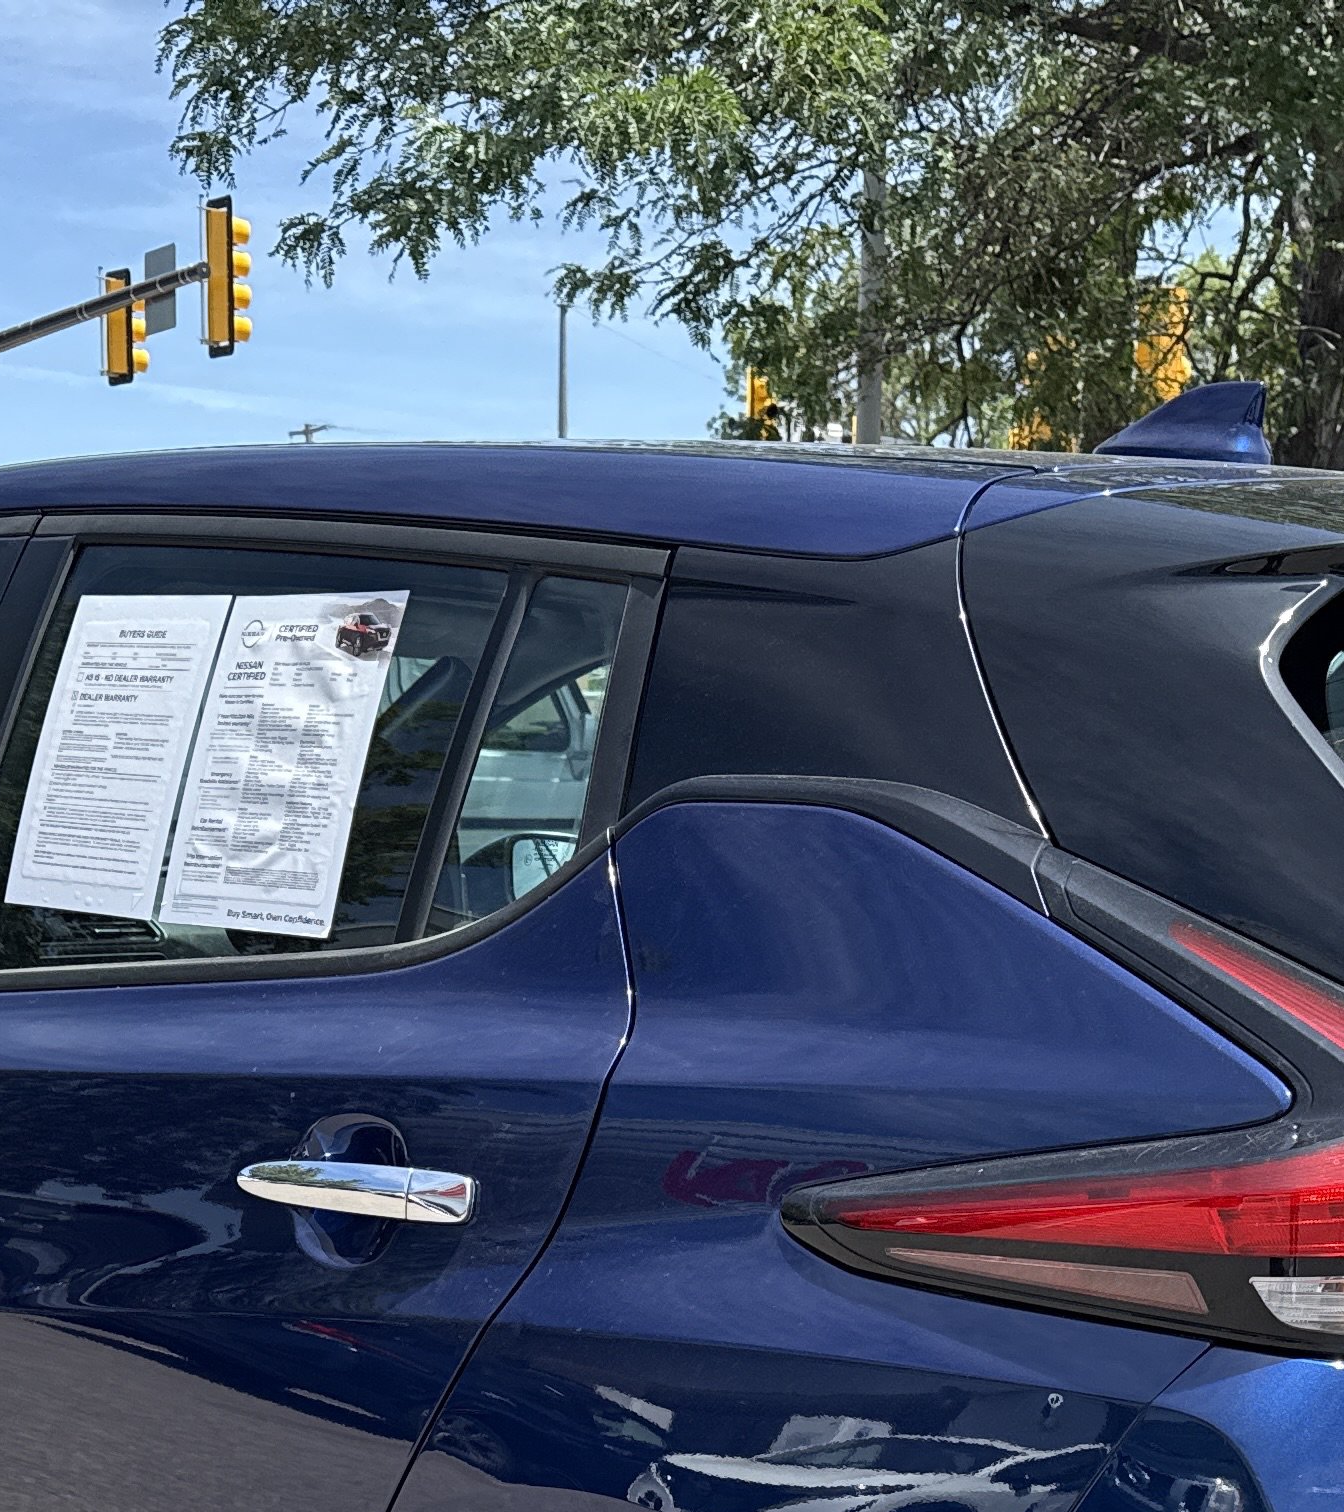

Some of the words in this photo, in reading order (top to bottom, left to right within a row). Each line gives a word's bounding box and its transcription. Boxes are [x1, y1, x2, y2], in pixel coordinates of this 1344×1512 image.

[119, 629, 146, 639] BUYERS
[146, 629, 168, 639] GUIDE
[279, 625, 319, 633] CERTIFIED
[235, 661, 264, 670] NISSAN
[114, 674, 139, 682] DEALER
[139, 675, 175, 684] WARRANTY
[227, 672, 266, 681] CERTIFIED
[79, 693, 104, 701] DEALER
[104, 694, 139, 703] WARRANTY
[227, 909, 241, 919] Buy
[266, 912, 283, 921] Own
